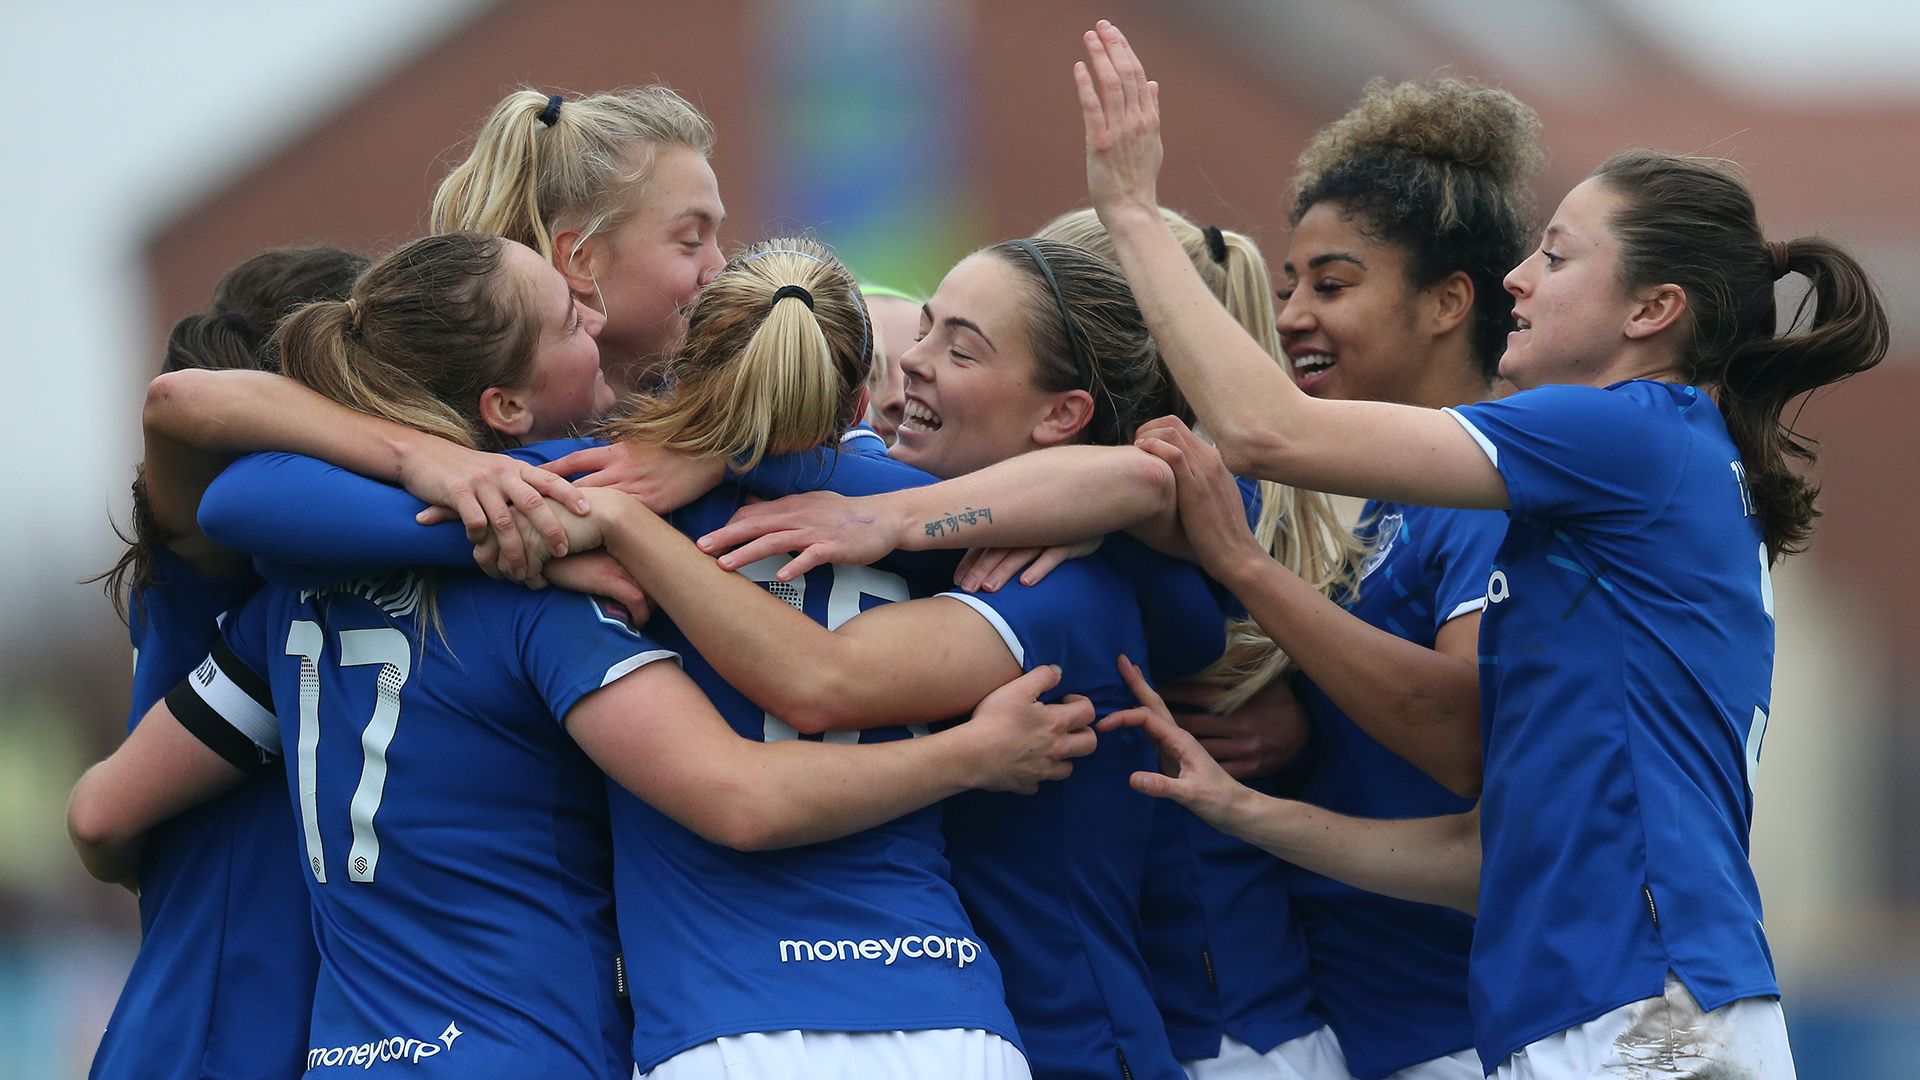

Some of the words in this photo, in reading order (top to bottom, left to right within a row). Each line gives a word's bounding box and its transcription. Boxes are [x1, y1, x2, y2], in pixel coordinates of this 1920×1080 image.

[285, 620, 411, 884] 17
[779, 935, 977, 968] moneycorp
[307, 1036, 441, 1071] moneycorp
